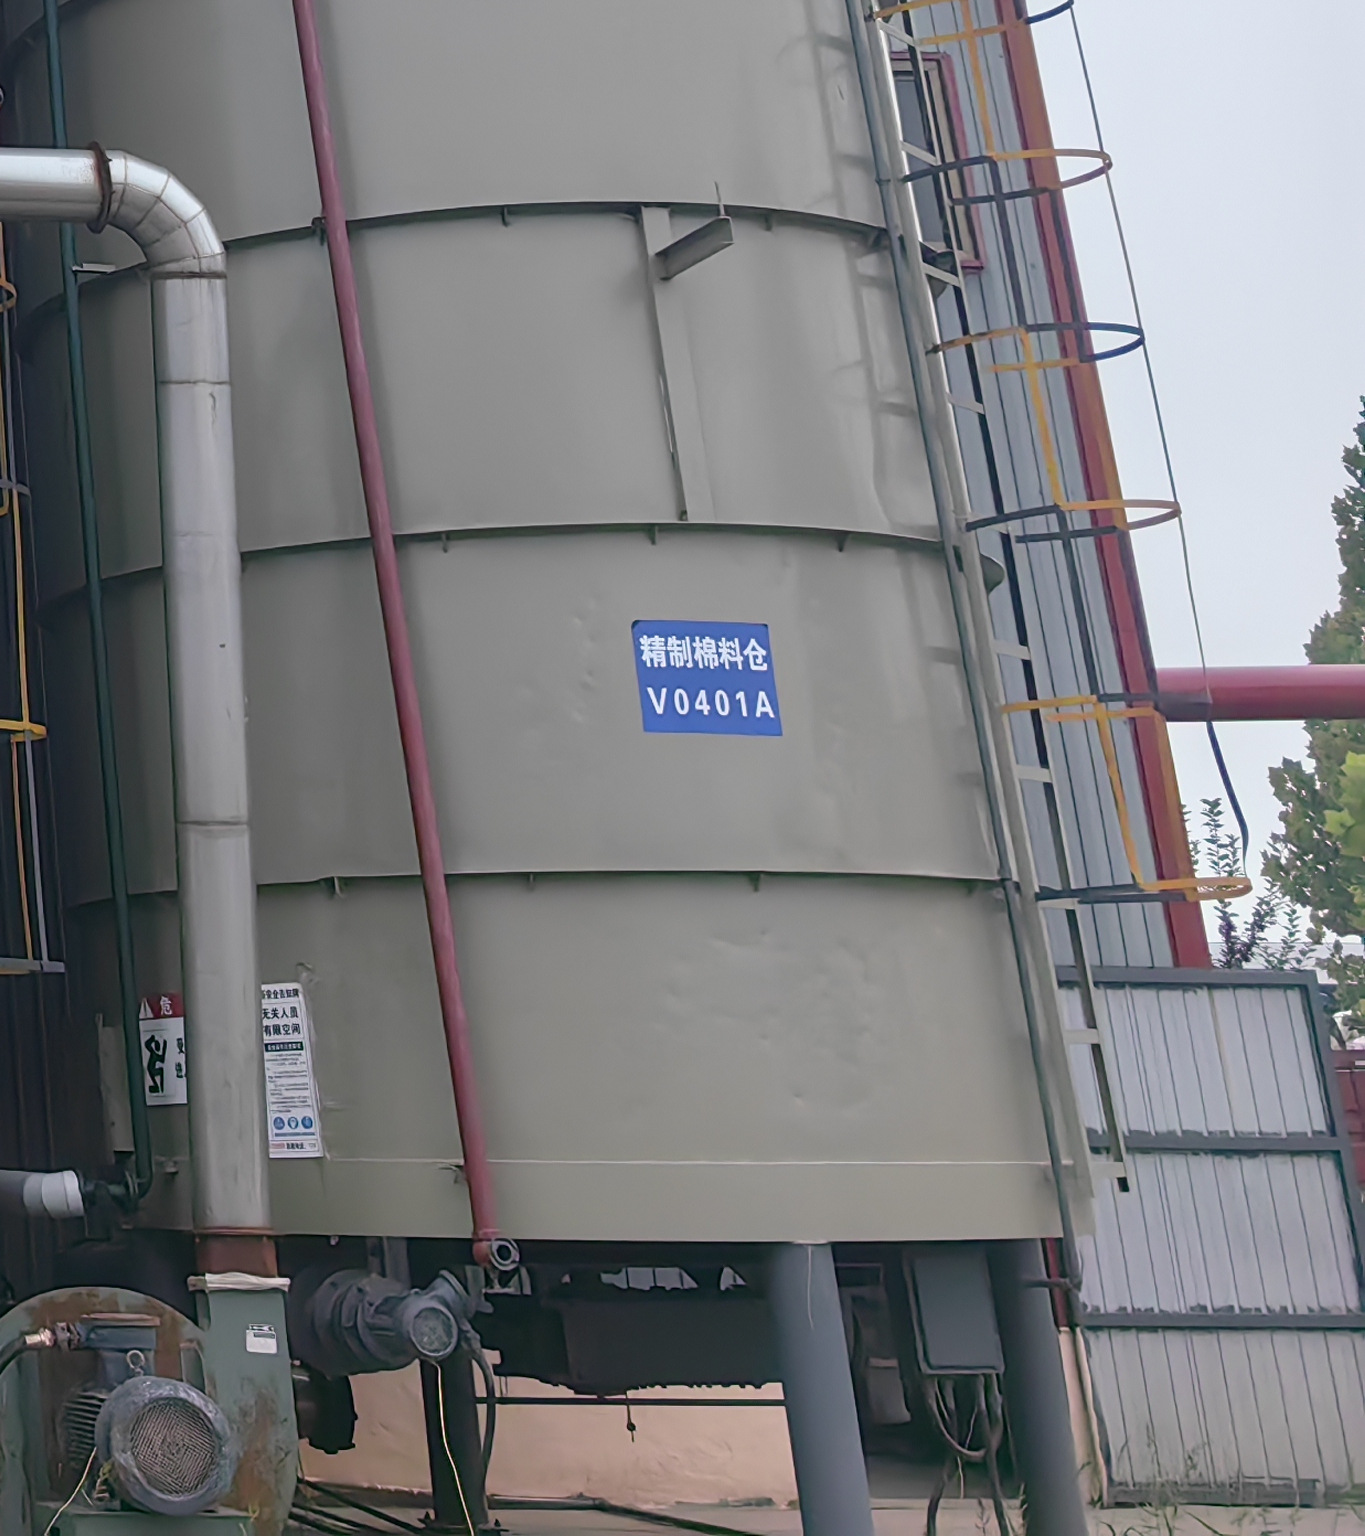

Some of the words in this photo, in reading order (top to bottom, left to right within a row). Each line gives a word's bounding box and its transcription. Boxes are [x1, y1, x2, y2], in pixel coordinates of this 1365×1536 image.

[639, 635, 768, 671] 精制棉料仓
[647, 687, 775, 718] V0401A
